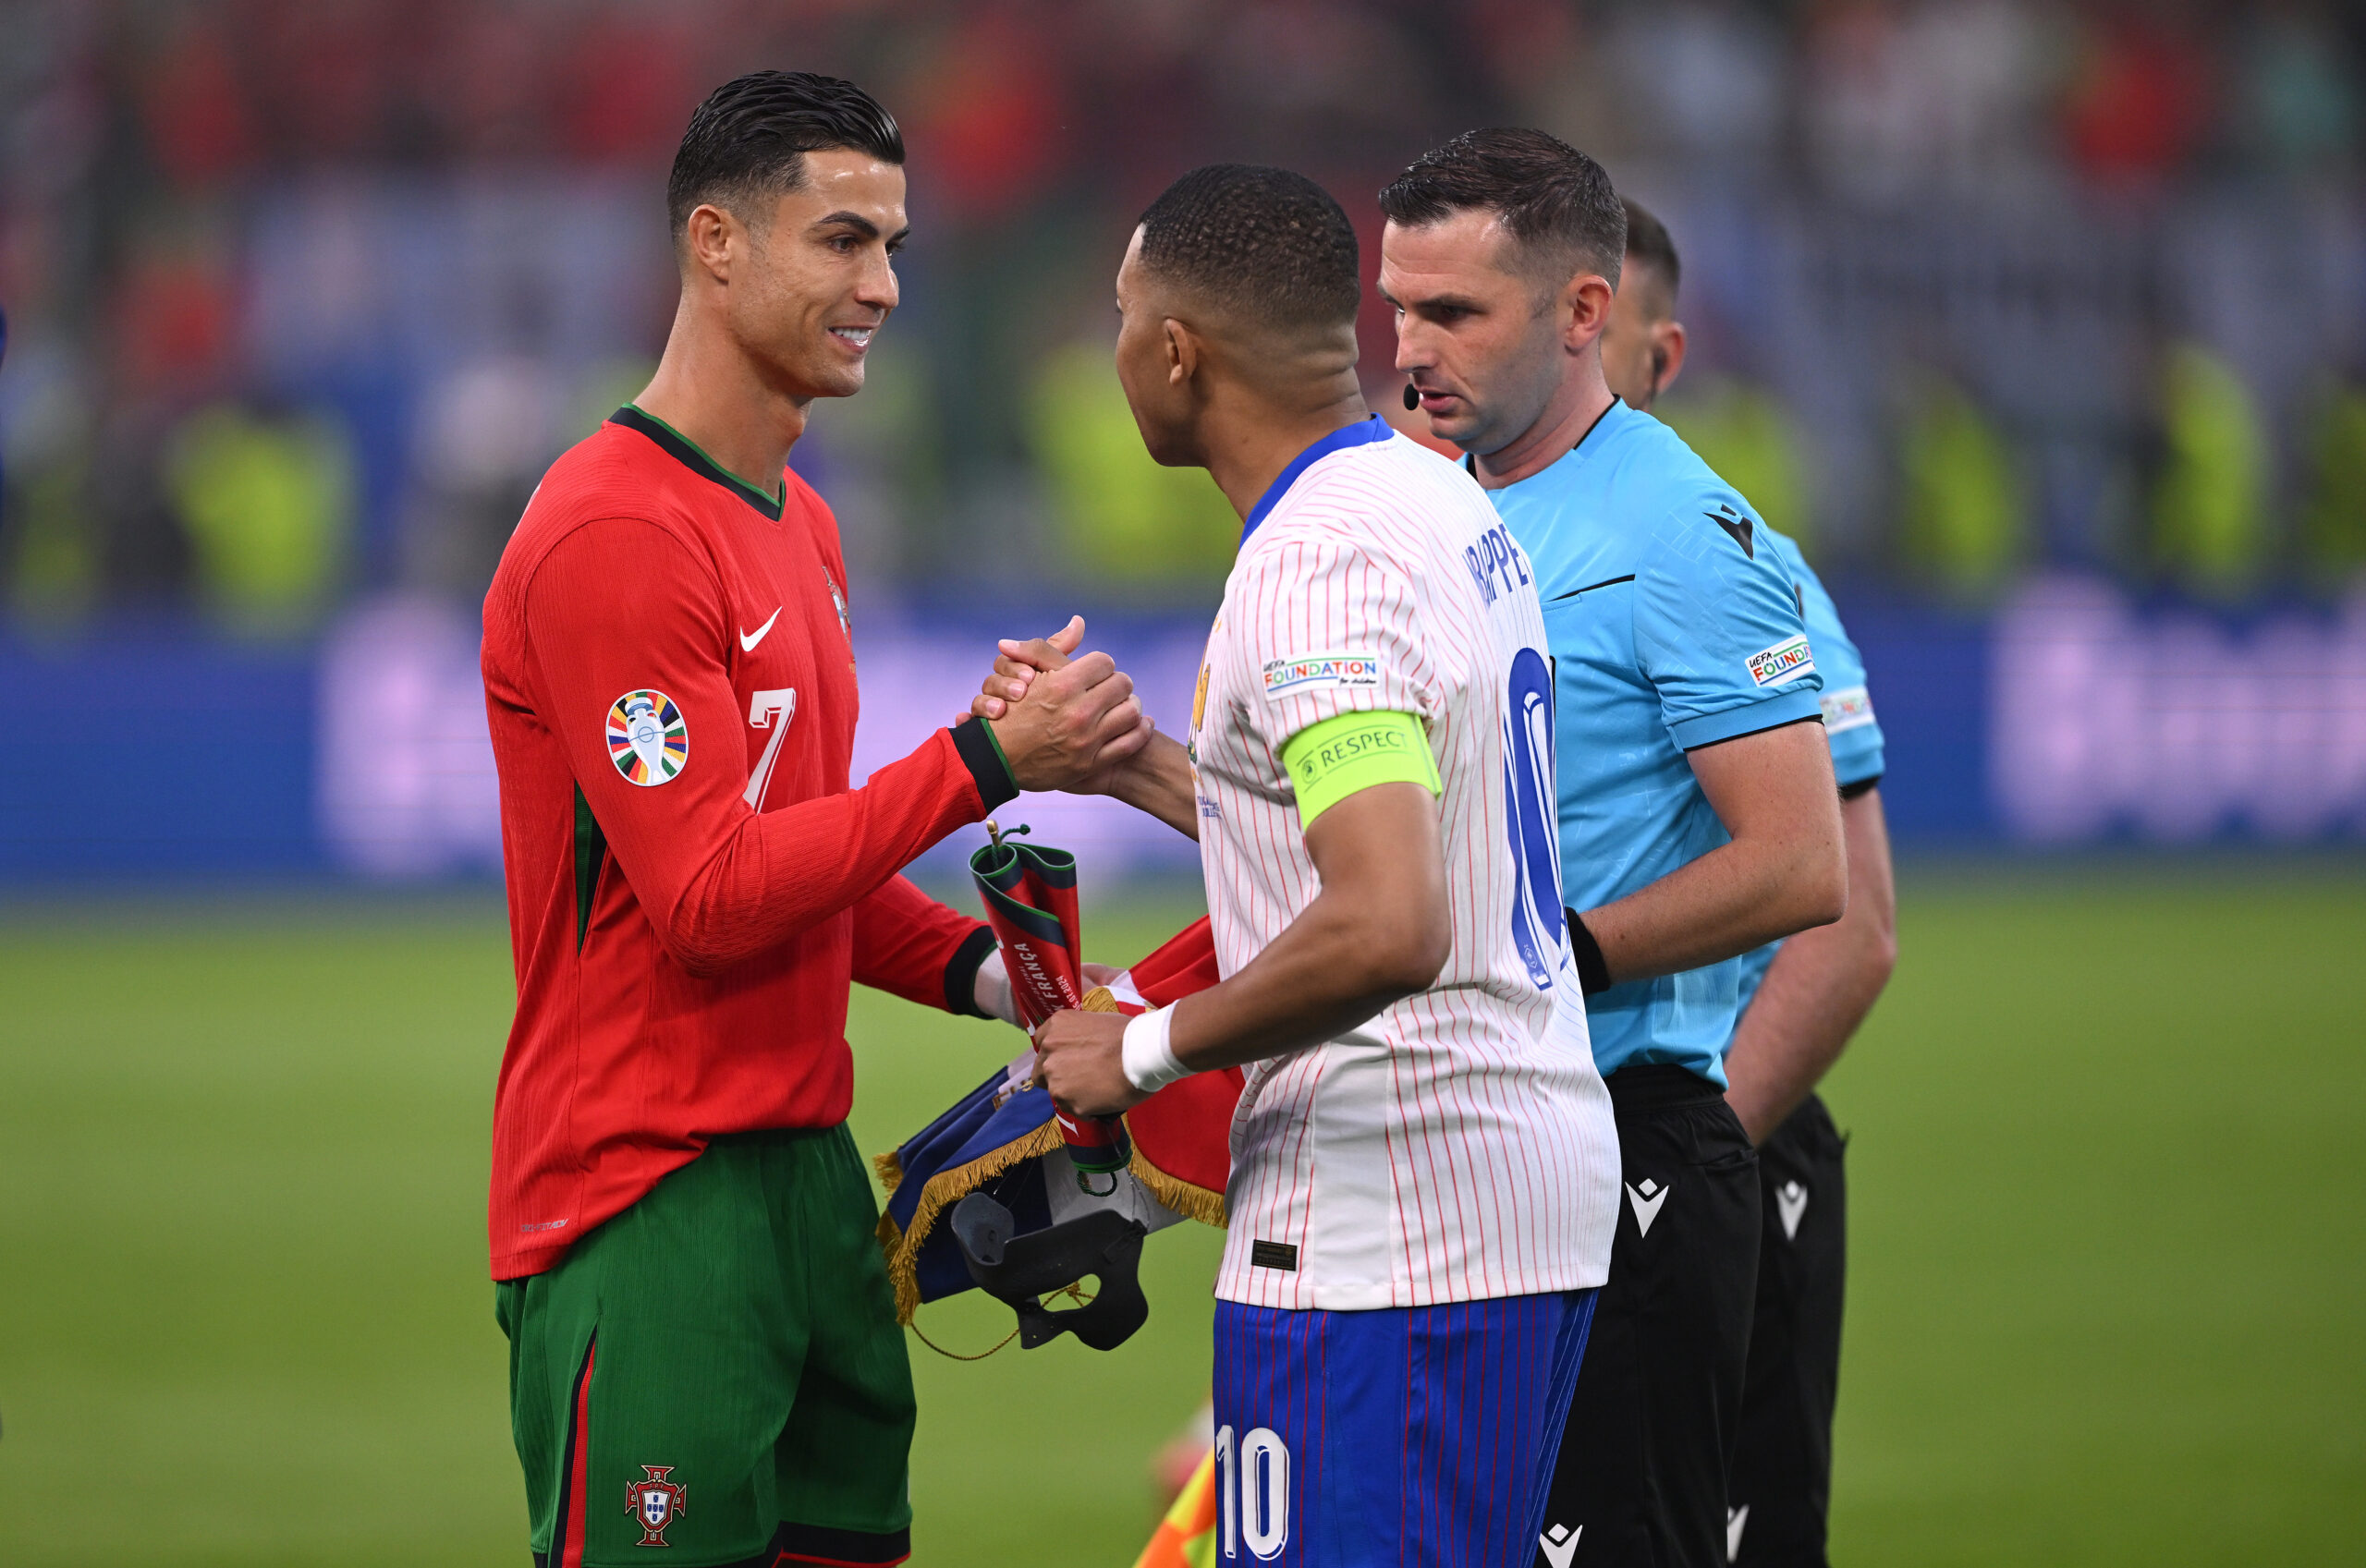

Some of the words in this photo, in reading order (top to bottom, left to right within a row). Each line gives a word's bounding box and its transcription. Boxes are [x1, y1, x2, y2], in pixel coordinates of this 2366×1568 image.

[1264, 661, 1376, 687] FOUNDATION
[1749, 650, 1773, 668] UEFA
[742, 687, 797, 816] 7
[1320, 731, 1408, 768] RESPECT
[1014, 942, 1059, 999] FRANÇA
[1216, 1424, 1290, 1561] 10
